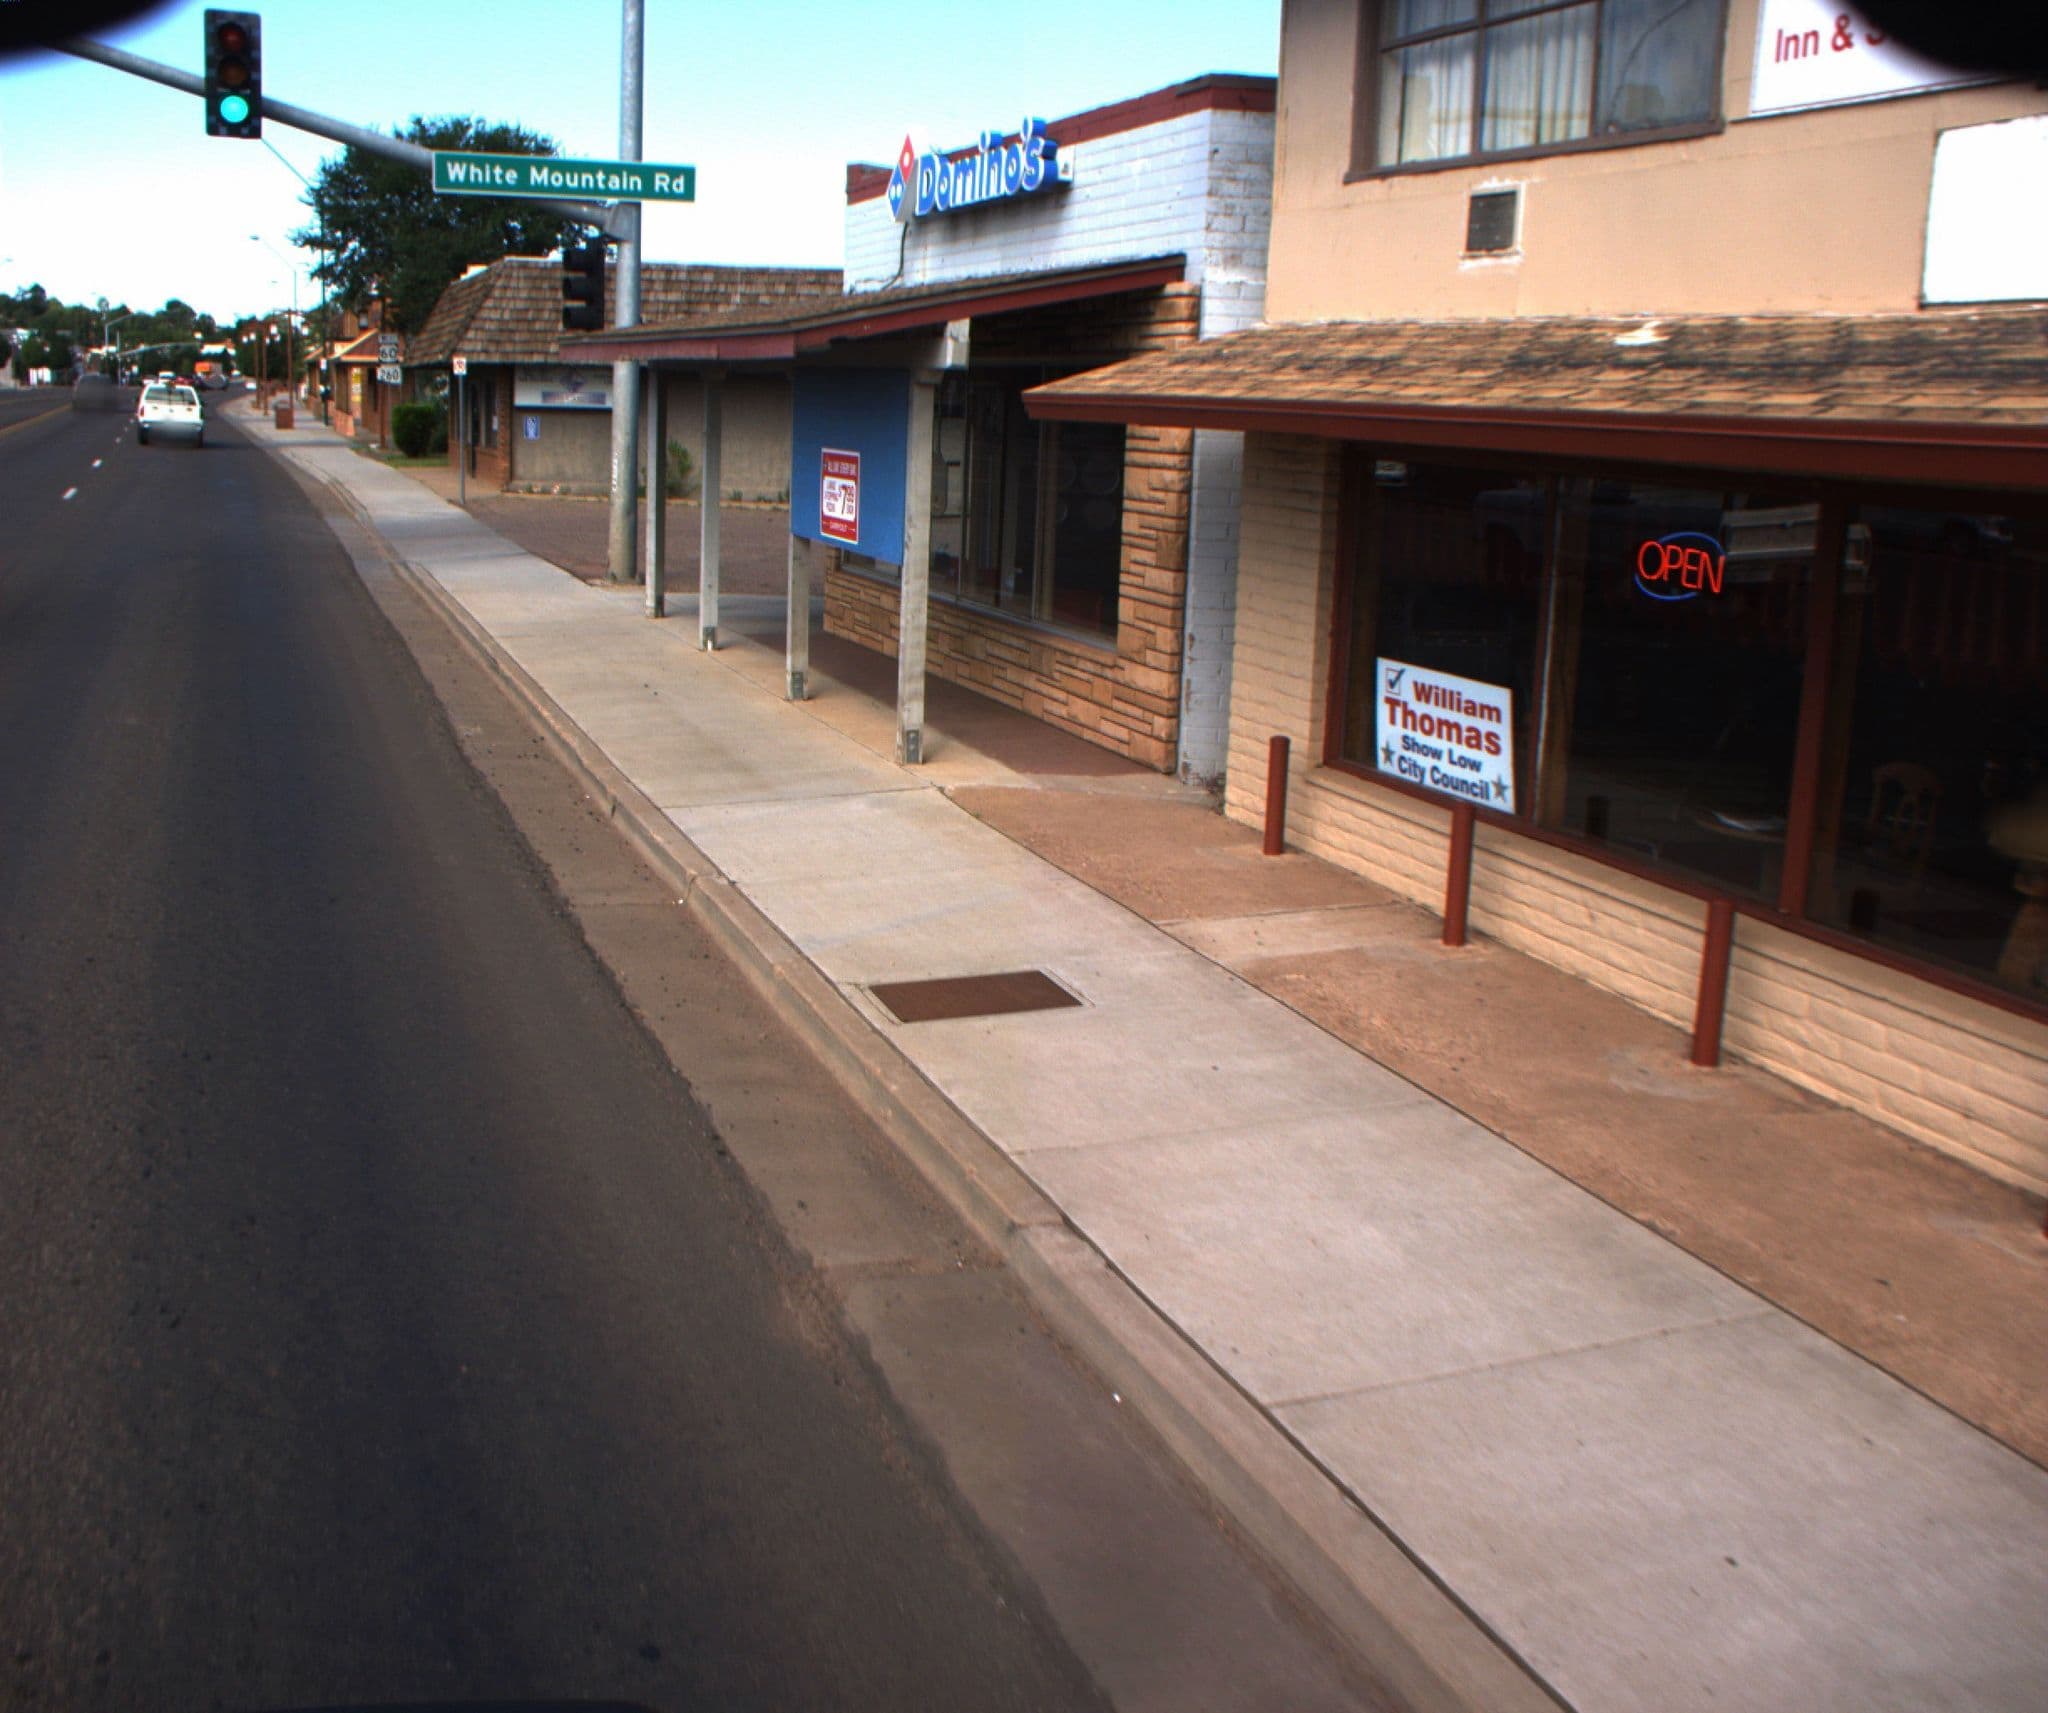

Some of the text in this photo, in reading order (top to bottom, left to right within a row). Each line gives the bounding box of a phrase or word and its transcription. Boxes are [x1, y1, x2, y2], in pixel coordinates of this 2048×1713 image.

[1776, 29, 1819, 63] Inn
[1831, 14, 1854, 51] &
[446, 160, 685, 194] White Mountain Rd
[915, 115, 1048, 216] Domino's
[1637, 540, 1726, 593] OPEN
[1413, 680, 1502, 724] William
[1384, 696, 1502, 756] Thomas
[1397, 754, 1490, 800] City Council
[1401, 734, 1482, 773] Show Low
